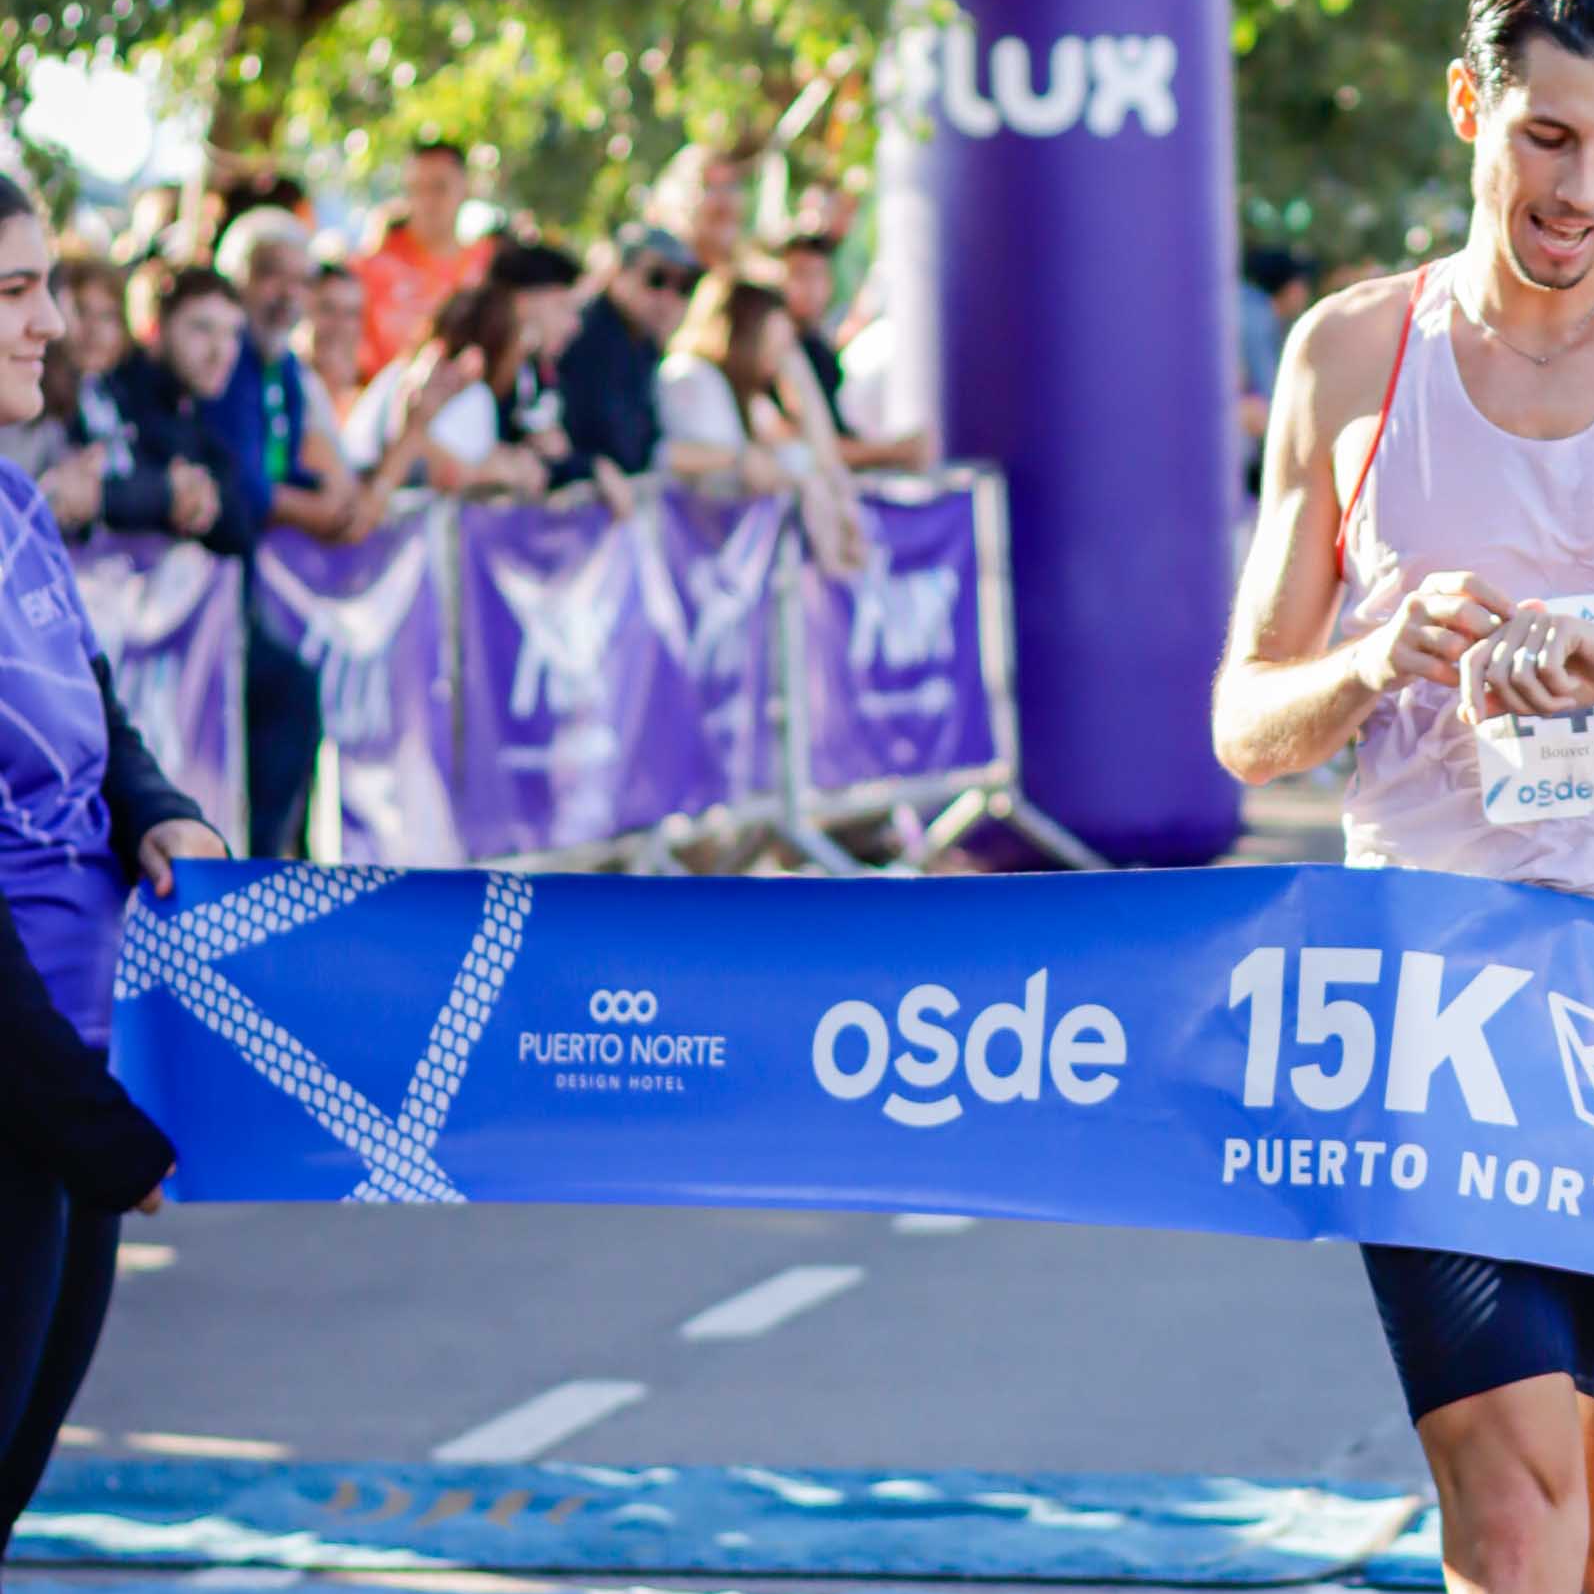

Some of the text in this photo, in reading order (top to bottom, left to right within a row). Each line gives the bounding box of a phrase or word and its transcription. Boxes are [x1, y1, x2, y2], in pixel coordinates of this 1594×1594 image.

[1518, 774, 1594, 806] osde
[518, 1031, 727, 1067] PUERTO NORTE
[813, 967, 1127, 1107] osde
[1228, 947, 1534, 1127] 15K
[555, 1073, 685, 1093] DESIGN HOTEL
[1222, 1138, 1429, 1190] PUERTO
